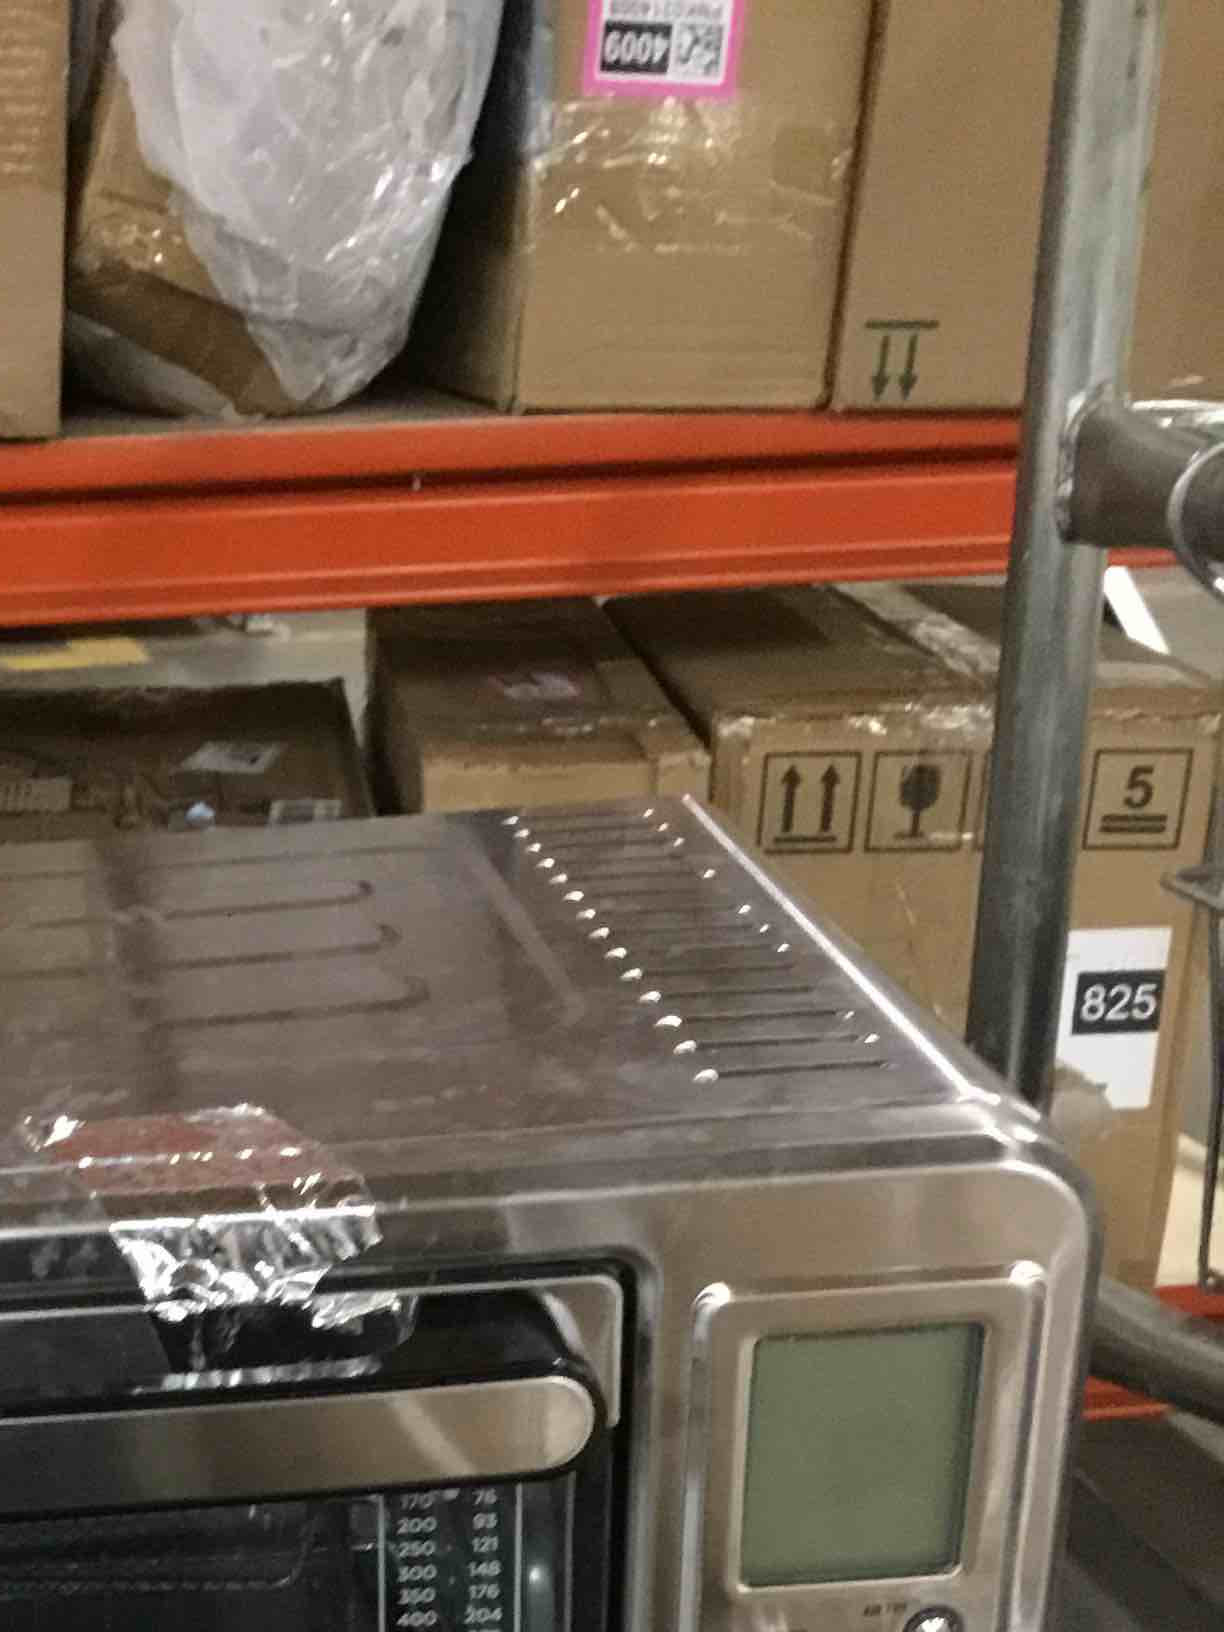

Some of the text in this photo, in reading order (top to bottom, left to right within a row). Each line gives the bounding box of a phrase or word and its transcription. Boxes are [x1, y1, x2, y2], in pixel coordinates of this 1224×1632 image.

[605, 31, 669, 65] 4009
[1122, 765, 1155, 809] 5
[1079, 982, 1158, 1022] 825
[396, 1516, 438, 1536] 200
[398, 1540, 437, 1559] 250
[396, 1563, 438, 1583] 300
[396, 1609, 439, 1628] 400
